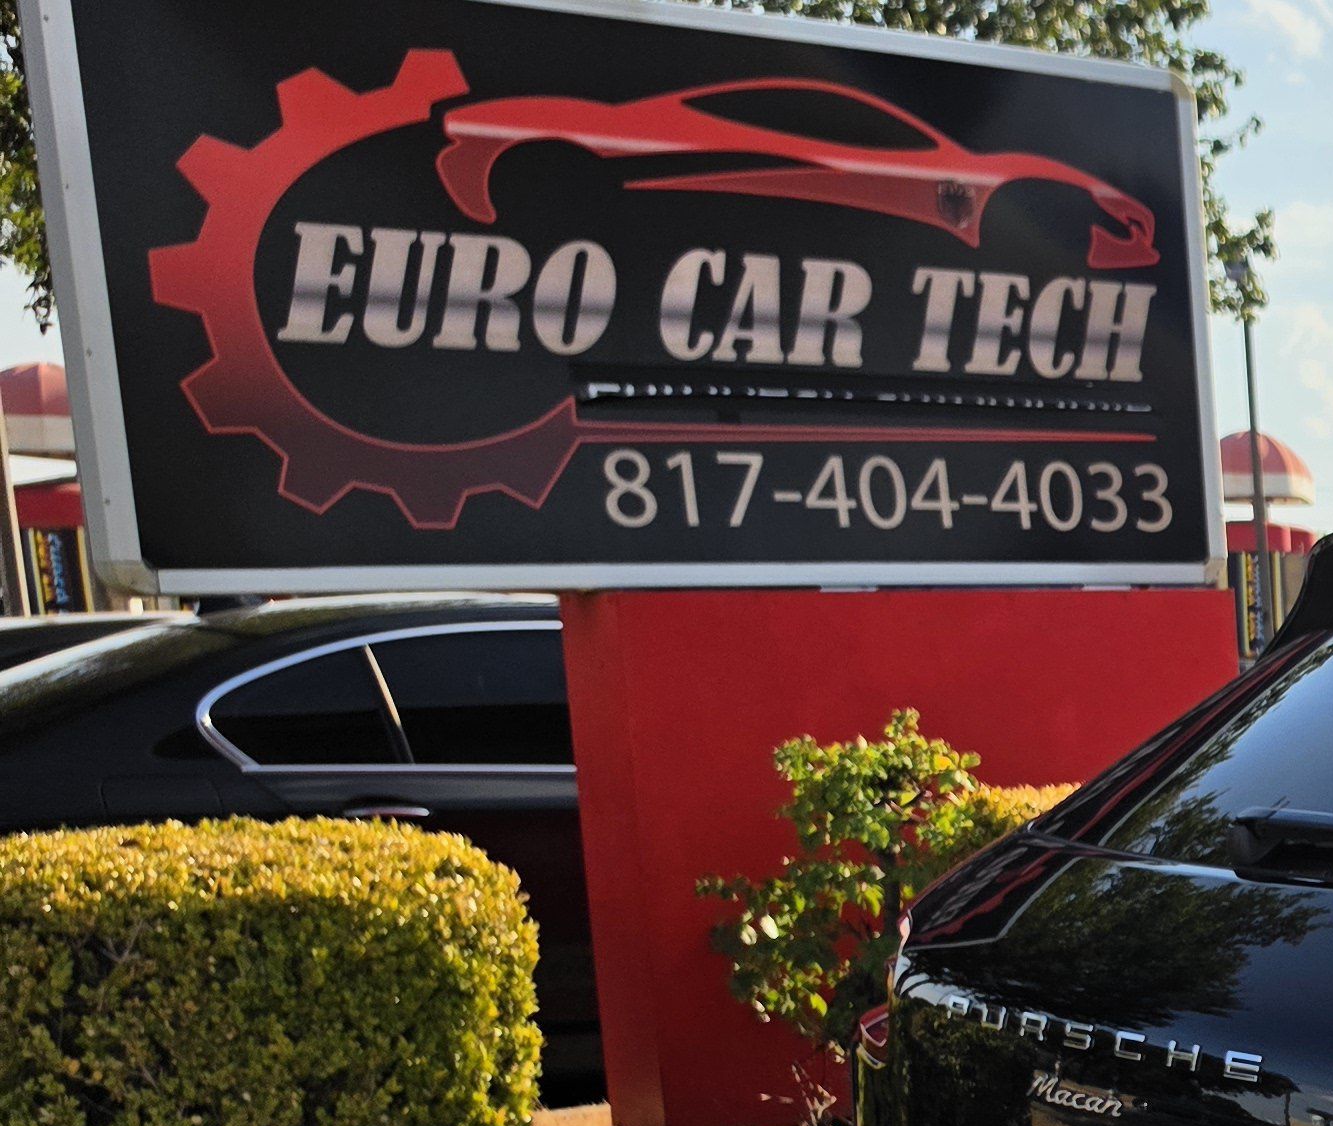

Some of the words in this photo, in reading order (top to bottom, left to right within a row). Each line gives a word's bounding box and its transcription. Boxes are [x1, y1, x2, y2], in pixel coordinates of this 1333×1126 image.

[278, 220, 617, 357] EURO
[657, 247, 873, 369] CAR
[911, 266, 1158, 384] TECH
[603, 449, 1174, 534] 817-404-4033
[946, 994, 1263, 1083] PORSCHE
[1026, 1073, 1123, 1118] Macan
